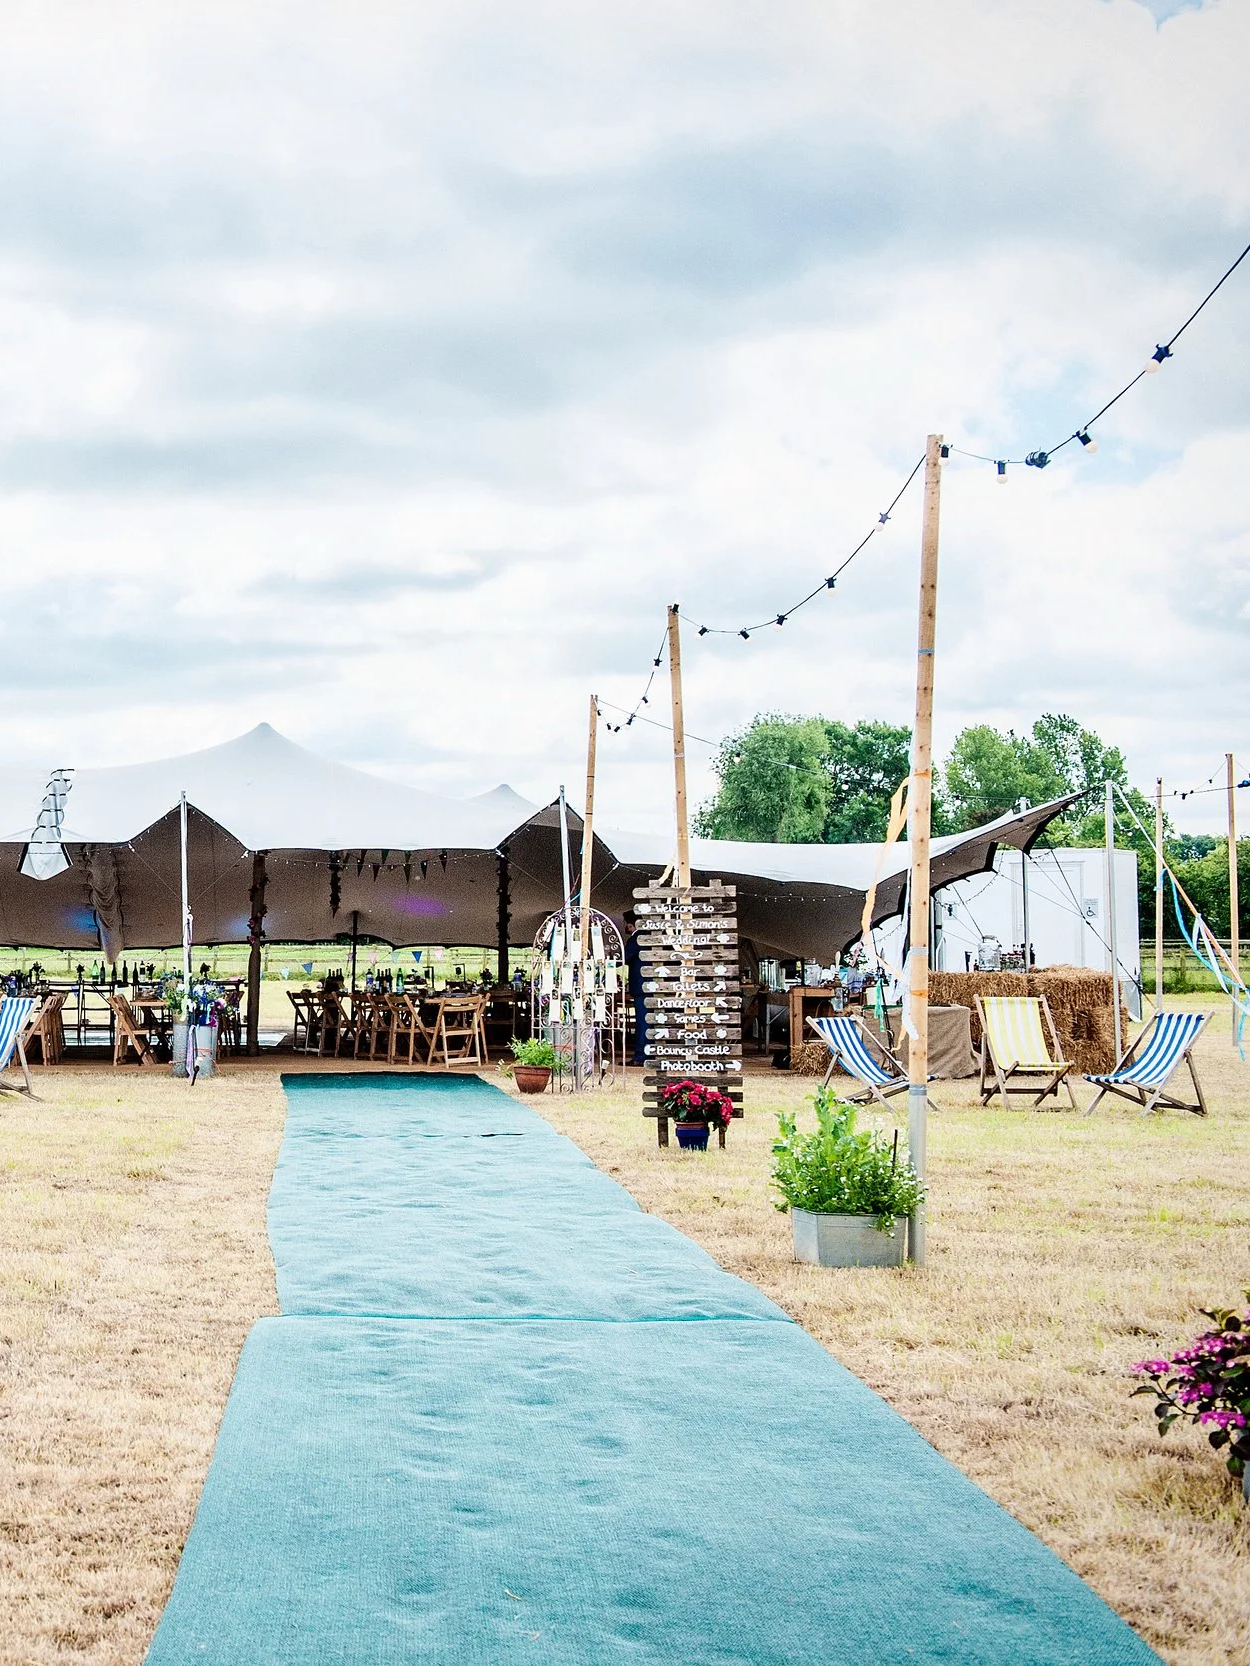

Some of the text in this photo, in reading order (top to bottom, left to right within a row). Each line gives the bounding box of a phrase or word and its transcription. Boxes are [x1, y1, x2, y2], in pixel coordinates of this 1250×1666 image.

[655, 904, 714, 913] Welcome to
[642, 919, 671, 929] Susie
[675, 919, 684, 930] &
[681, 967, 701, 976] Bar
[672, 982, 710, 992] Toilets
[657, 1045, 730, 1056] Bouncy Castle
